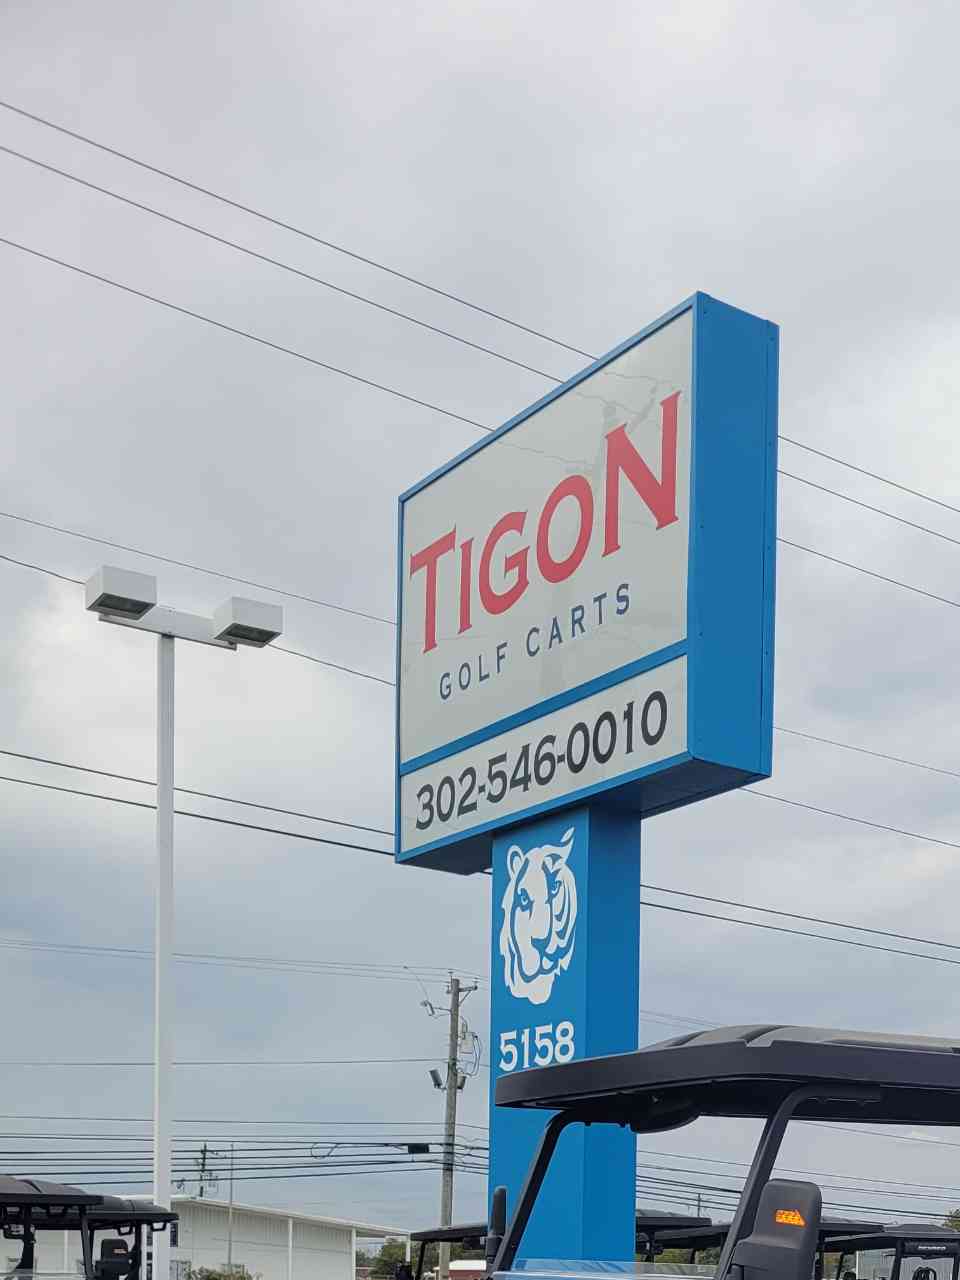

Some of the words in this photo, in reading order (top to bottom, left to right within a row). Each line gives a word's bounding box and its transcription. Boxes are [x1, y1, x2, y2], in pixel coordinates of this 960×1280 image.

[409, 390, 682, 655] TIGON
[439, 642, 508, 701] GOLF
[526, 582, 631, 658] CARTS
[415, 690, 668, 831] 302-546-0010
[499, 1021, 575, 1072] 5158
